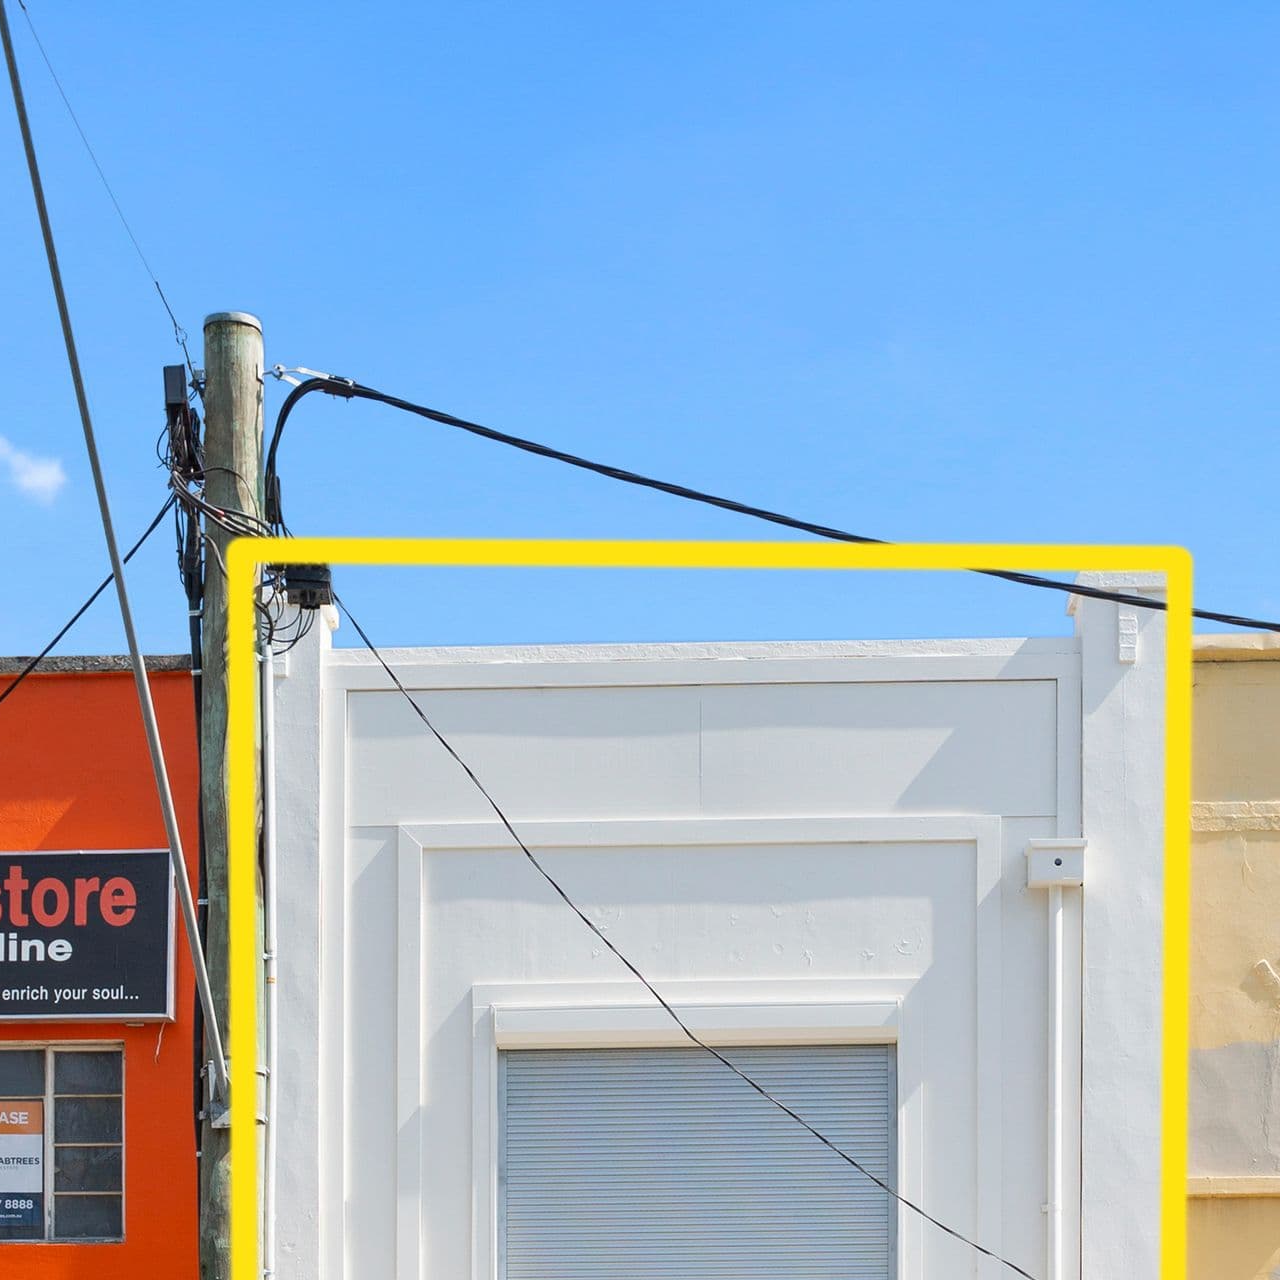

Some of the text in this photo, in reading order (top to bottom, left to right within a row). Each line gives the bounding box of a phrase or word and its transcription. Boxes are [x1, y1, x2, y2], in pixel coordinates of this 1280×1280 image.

[2, 986, 49, 1001] enrich
[54, 988, 89, 1004] your
[4, 1199, 34, 1209] 8888
